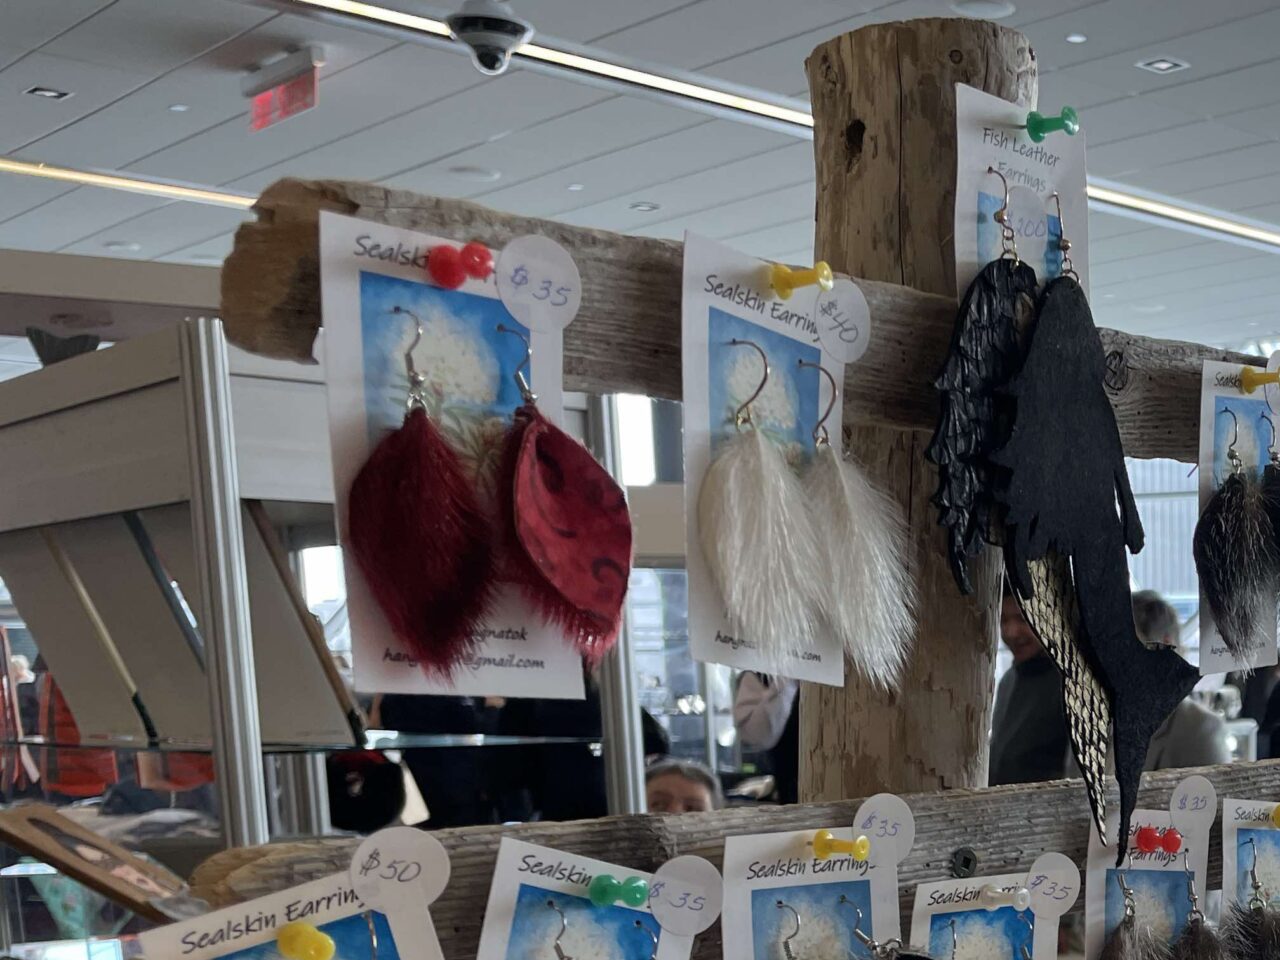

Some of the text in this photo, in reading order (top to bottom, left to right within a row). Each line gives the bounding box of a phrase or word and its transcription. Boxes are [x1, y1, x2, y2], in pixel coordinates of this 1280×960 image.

[982, 127, 1061, 167] Fish Leather
[997, 161, 1046, 192] Earrings
[353, 234, 431, 269] Sealski
[704, 274, 820, 342] Sealskin Earrin
[1214, 372, 1241, 389] Sealsk
[382, 648, 545, 671] hang@gmail.com
[1234, 806, 1270, 823] Sealskin
[359, 848, 421, 883] $50
[518, 854, 592, 887] Sealskin
[747, 858, 806, 881] Sealskin
[927, 886, 981, 907] Sealskin
[181, 886, 365, 955] Sealskin Earrin
